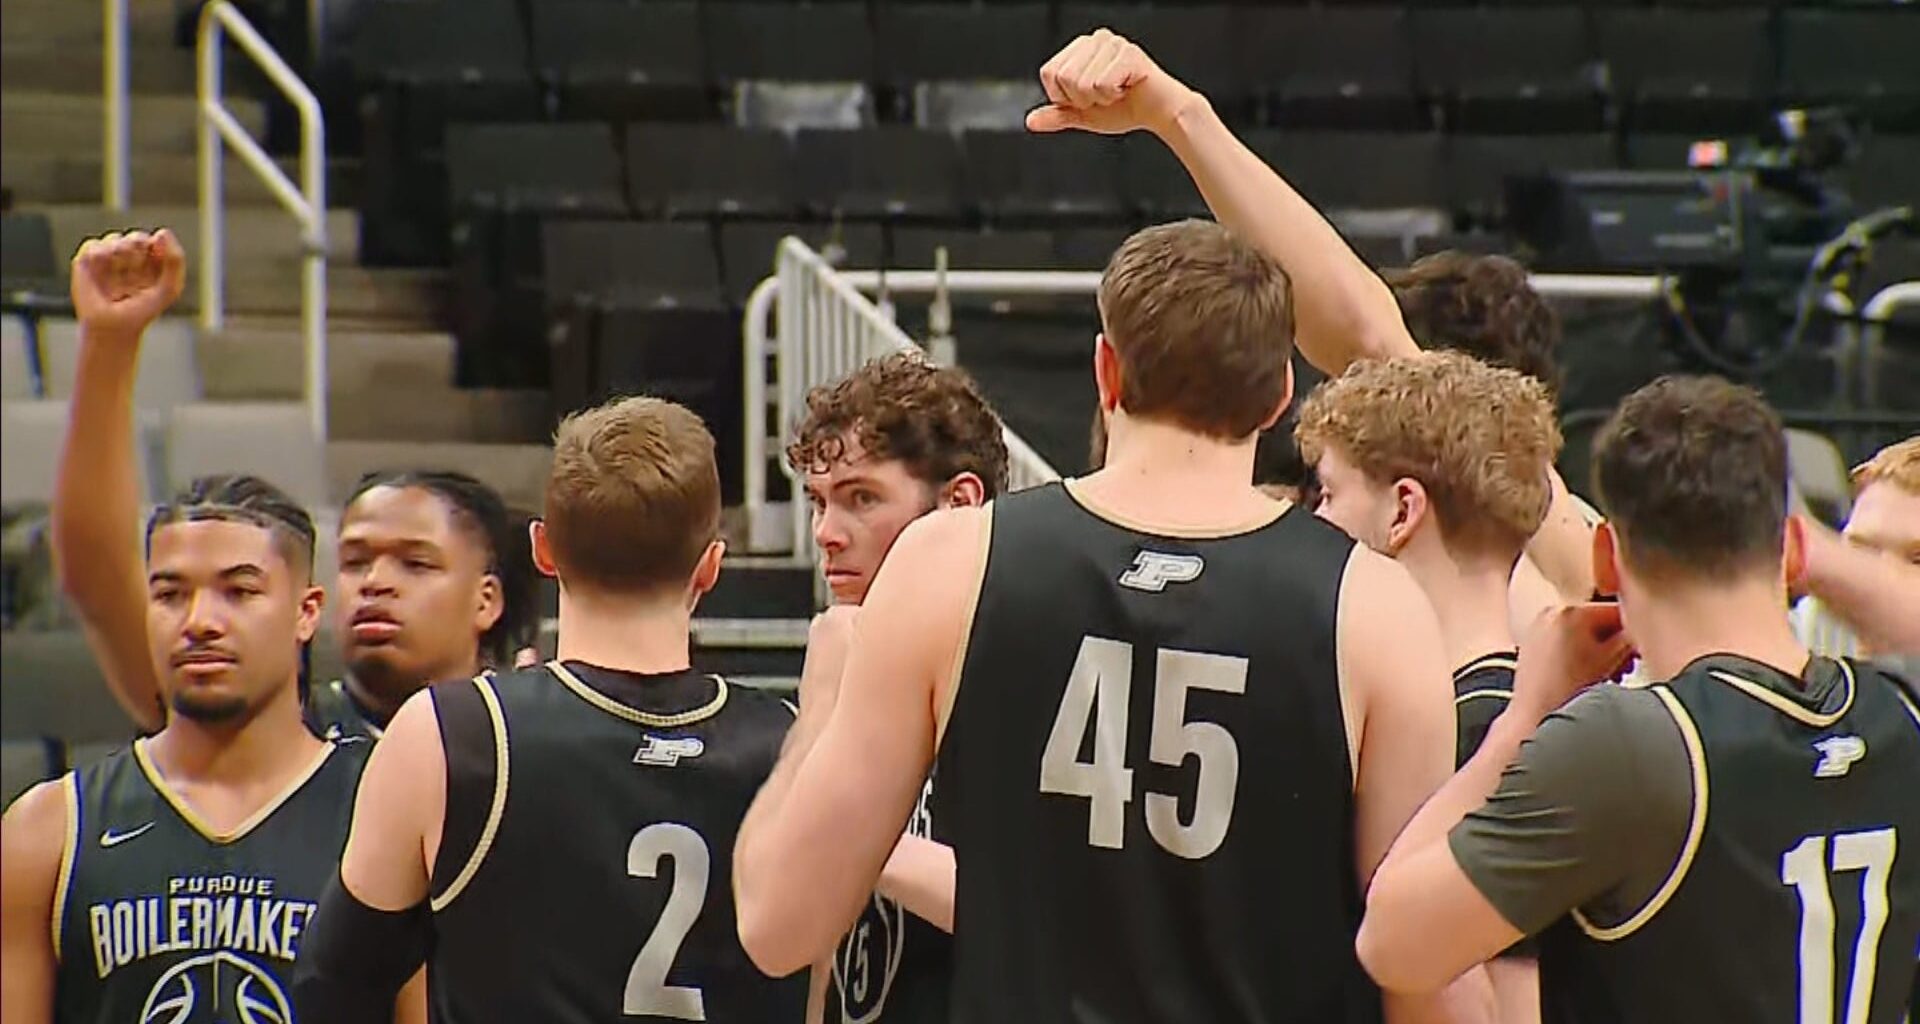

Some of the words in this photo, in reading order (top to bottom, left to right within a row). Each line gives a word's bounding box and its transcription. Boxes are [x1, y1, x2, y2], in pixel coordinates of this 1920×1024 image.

[1118, 550, 1204, 592] P
[632, 733, 704, 767] P
[1040, 635, 1249, 859] 45
[1811, 735, 1867, 777] P
[168, 875, 274, 896] PURDUE
[623, 822, 710, 1021] 2
[1782, 827, 1896, 1024] 17
